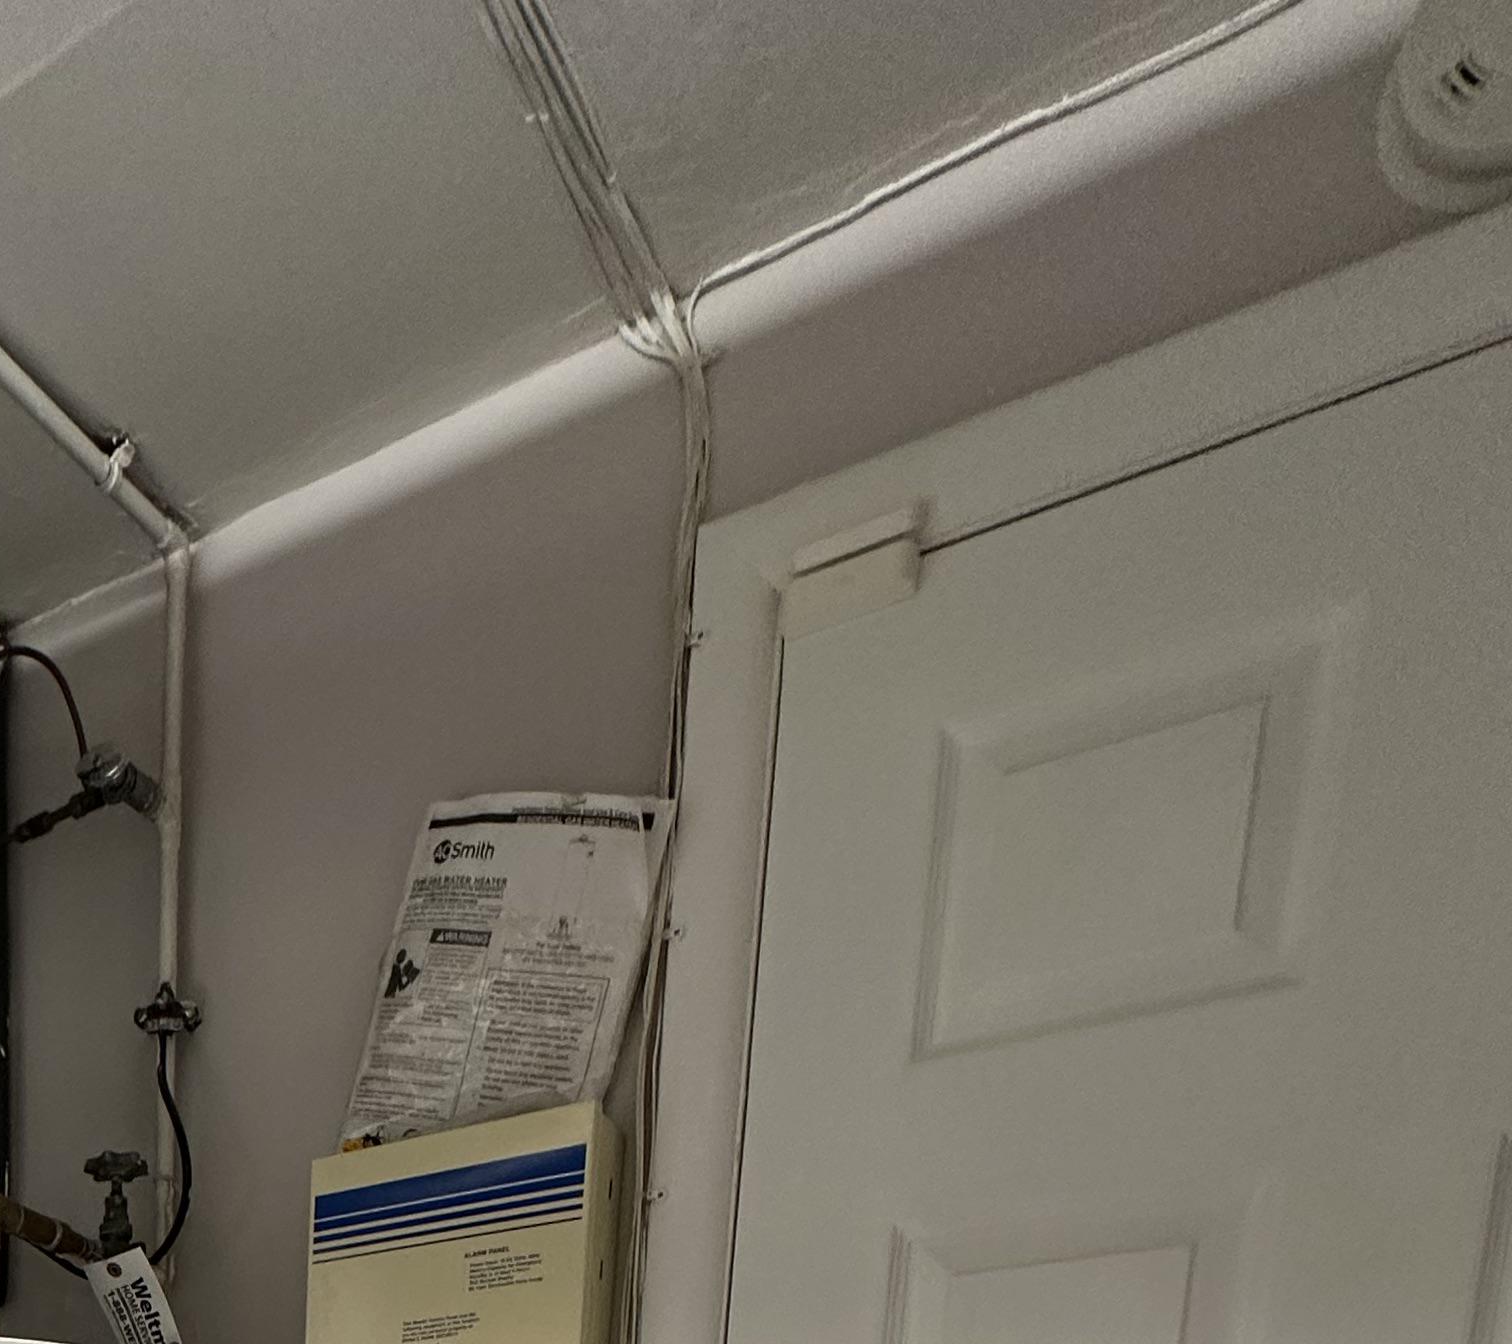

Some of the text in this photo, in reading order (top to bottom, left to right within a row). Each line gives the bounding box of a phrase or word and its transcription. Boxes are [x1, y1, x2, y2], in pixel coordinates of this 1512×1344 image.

[452, 840, 495, 860] Smith
[474, 876, 508, 888] HEATER
[120, 1284, 141, 1315] HOME
